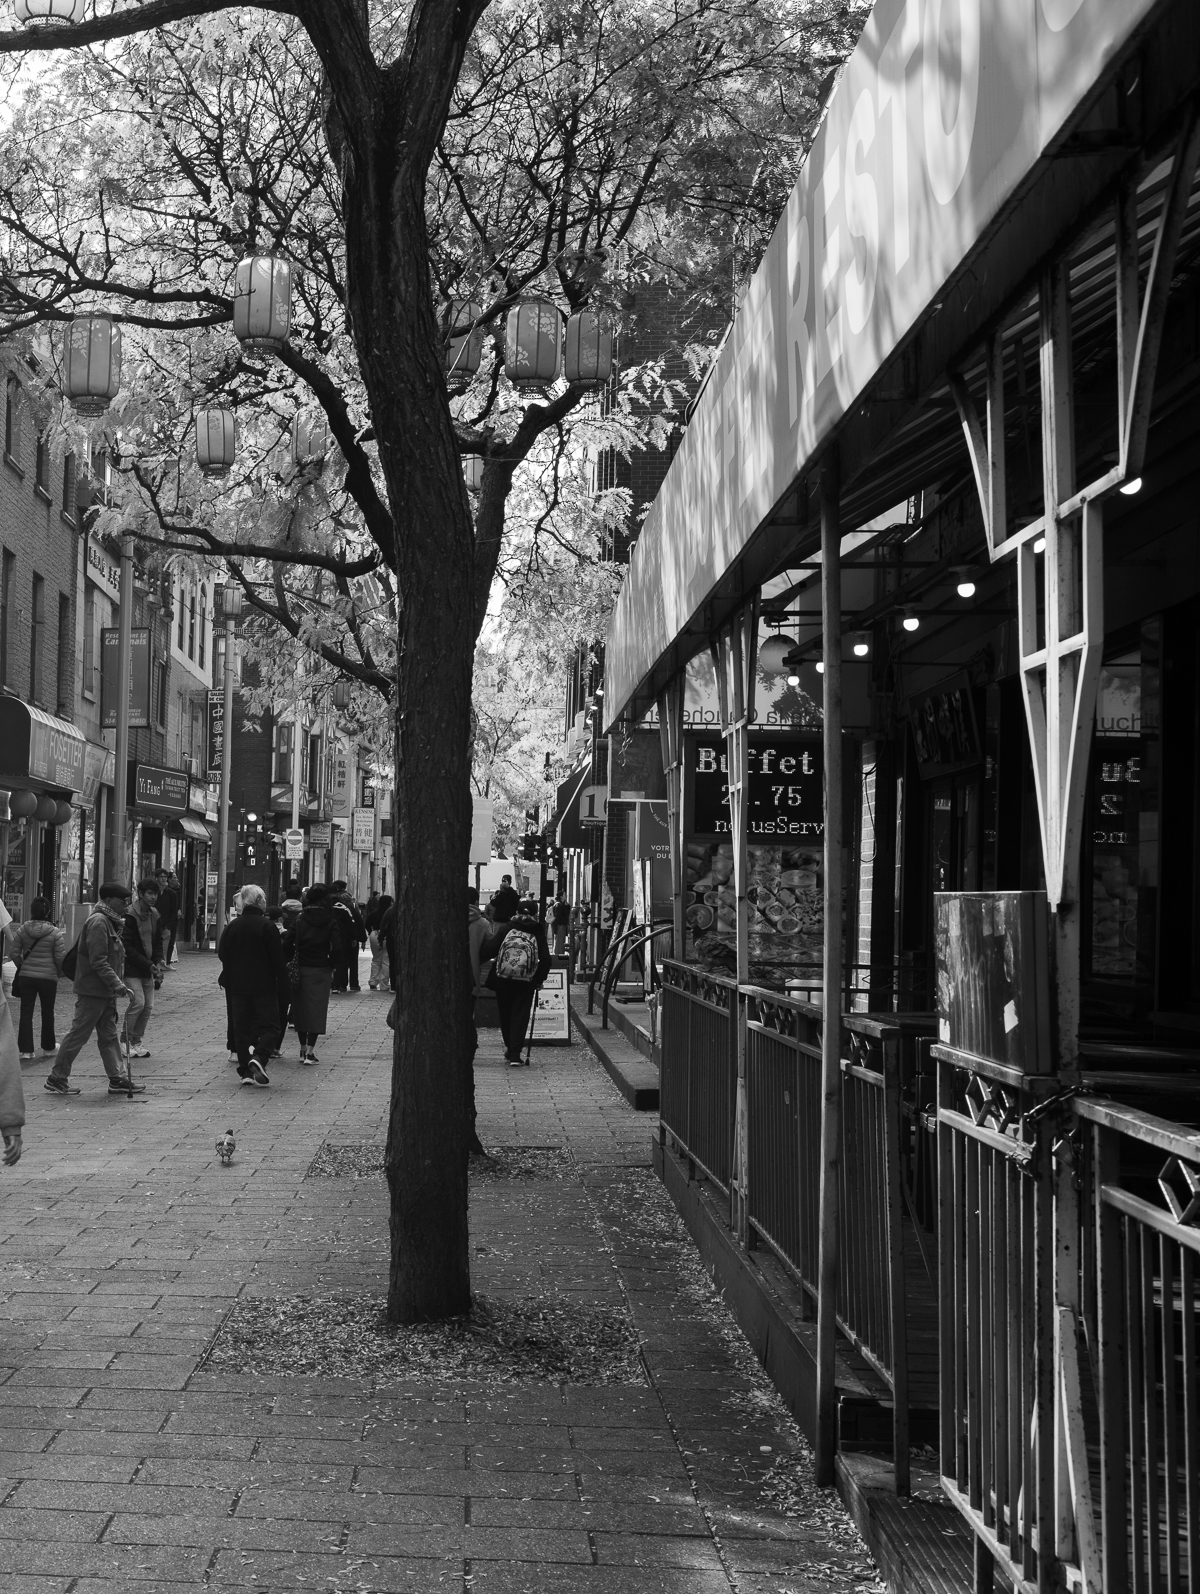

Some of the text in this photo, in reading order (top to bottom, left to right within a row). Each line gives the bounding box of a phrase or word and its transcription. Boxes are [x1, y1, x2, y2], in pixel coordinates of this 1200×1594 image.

[105, 638, 147, 646] Cannais
[49, 730, 83, 768] FOSETTER
[695, 748, 814, 774] Bfet
[721, 784, 802, 806] 2.75
[714, 816, 824, 834] nusServ
